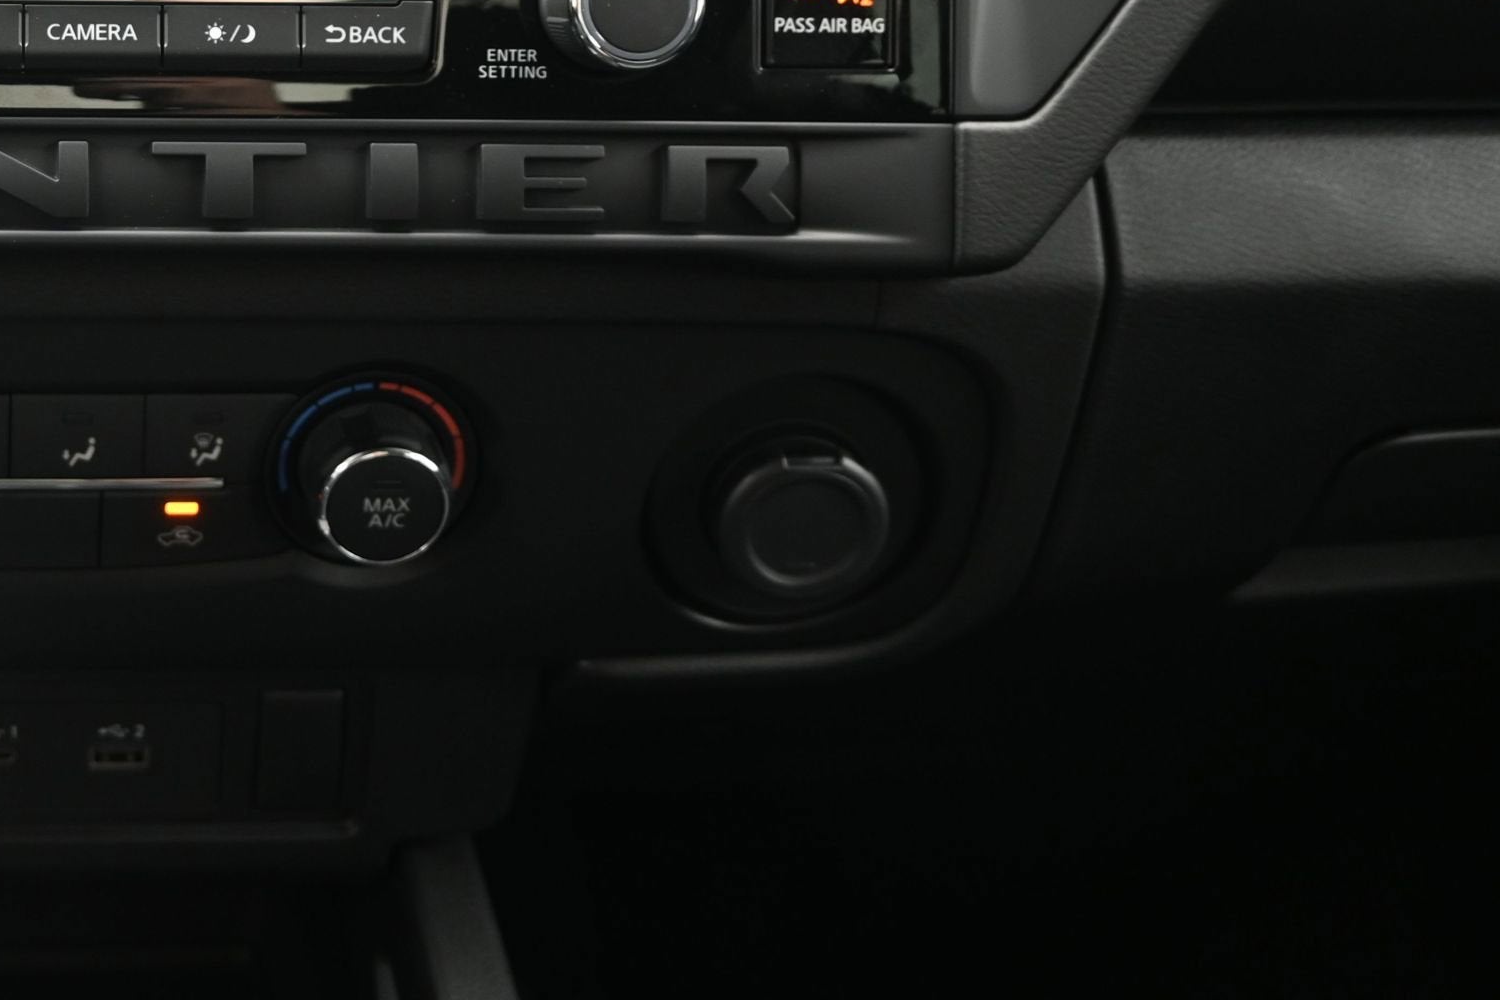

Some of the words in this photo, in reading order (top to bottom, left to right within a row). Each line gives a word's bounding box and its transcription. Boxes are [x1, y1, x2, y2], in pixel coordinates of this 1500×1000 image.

[46, 23, 138, 41] CAMERA
[774, 17, 815, 33] PASS
[818, 17, 848, 33] AIR
[851, 17, 886, 33] BAG
[349, 26, 406, 44] BACK
[486, 48, 538, 62] ENTER
[478, 65, 548, 79] SETTING
[362, 496, 411, 512] MAX
[367, 512, 406, 528] A/C
